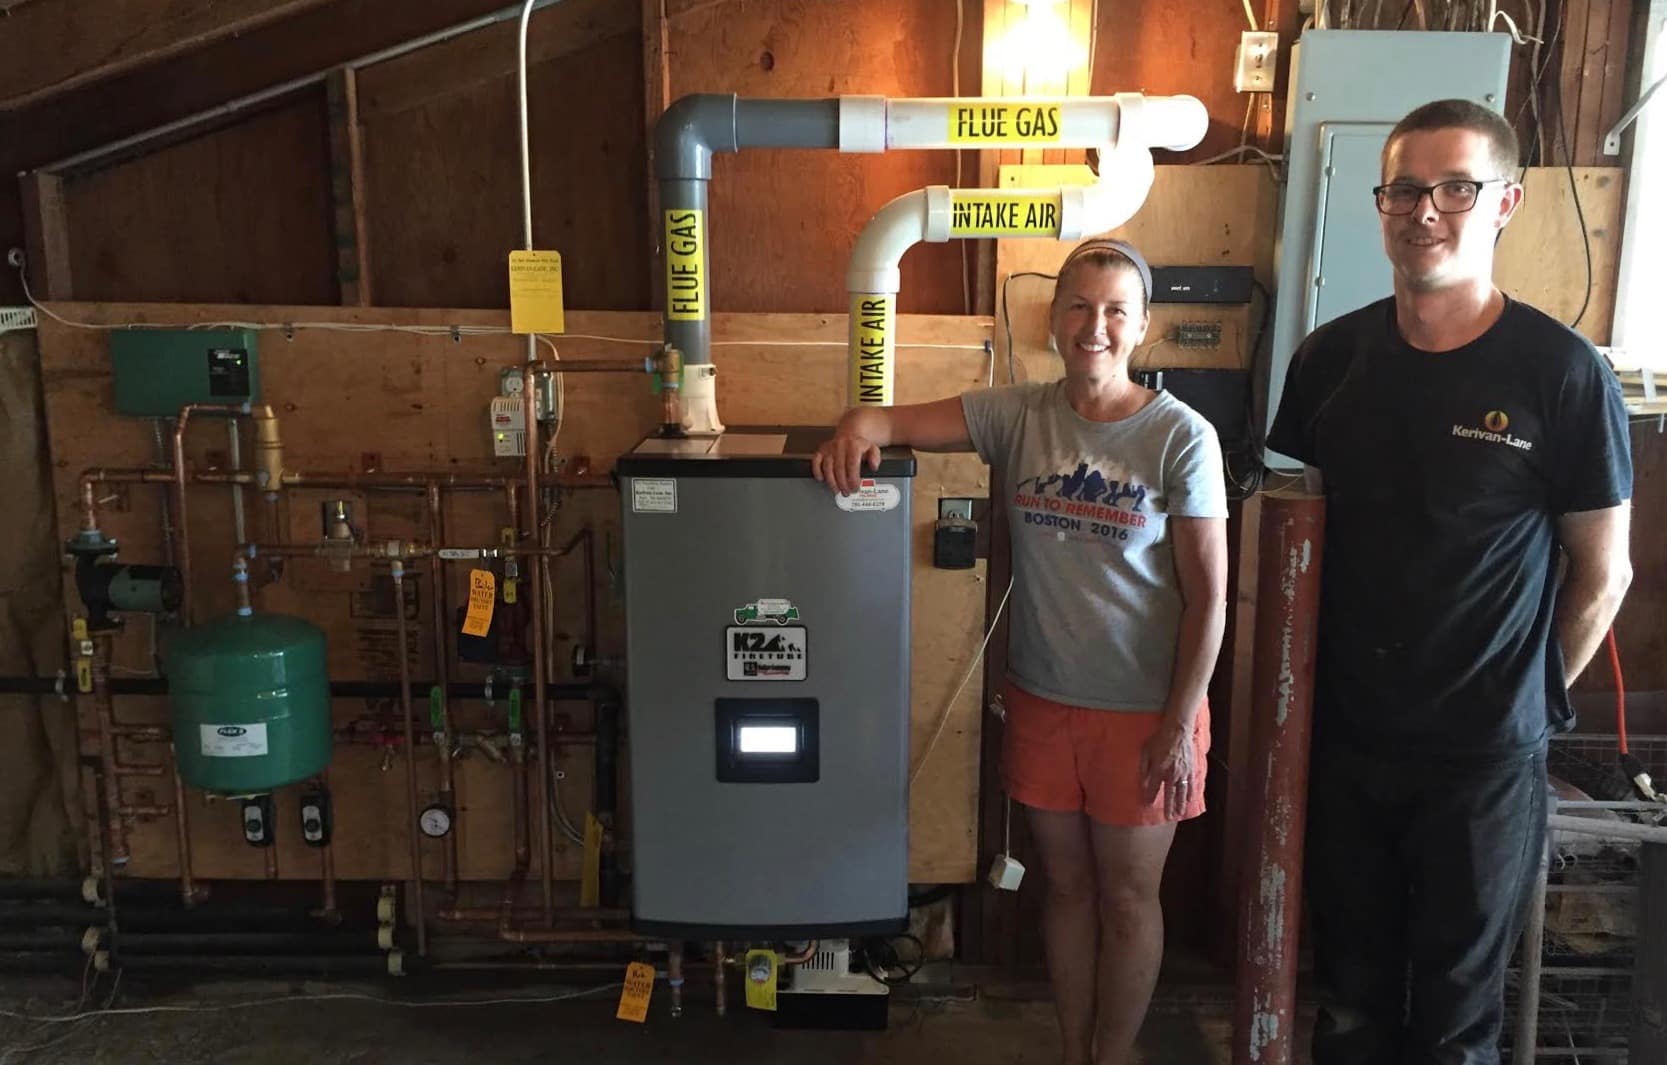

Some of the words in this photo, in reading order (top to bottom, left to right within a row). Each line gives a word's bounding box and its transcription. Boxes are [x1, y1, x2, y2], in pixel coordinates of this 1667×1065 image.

[957, 108, 1008, 137] FLUE
[1015, 107, 1058, 137] GAS
[952, 202, 1019, 229] INTAKE
[1024, 202, 1057, 229] AIR
[670, 213, 698, 257] GAS
[671, 264, 699, 314] FLUE
[861, 299, 886, 331] AIR
[859, 337, 885, 402] INTAKE
[1452, 424, 1533, 450] Kerivan-Lane
[1014, 494, 1040, 509] RUN
[1044, 498, 1061, 511] TO
[1065, 502, 1147, 527] REMEMBER
[1024, 511, 1080, 531] BOSTON
[1090, 522, 1129, 540] 2016
[733, 632, 766, 652] K2
